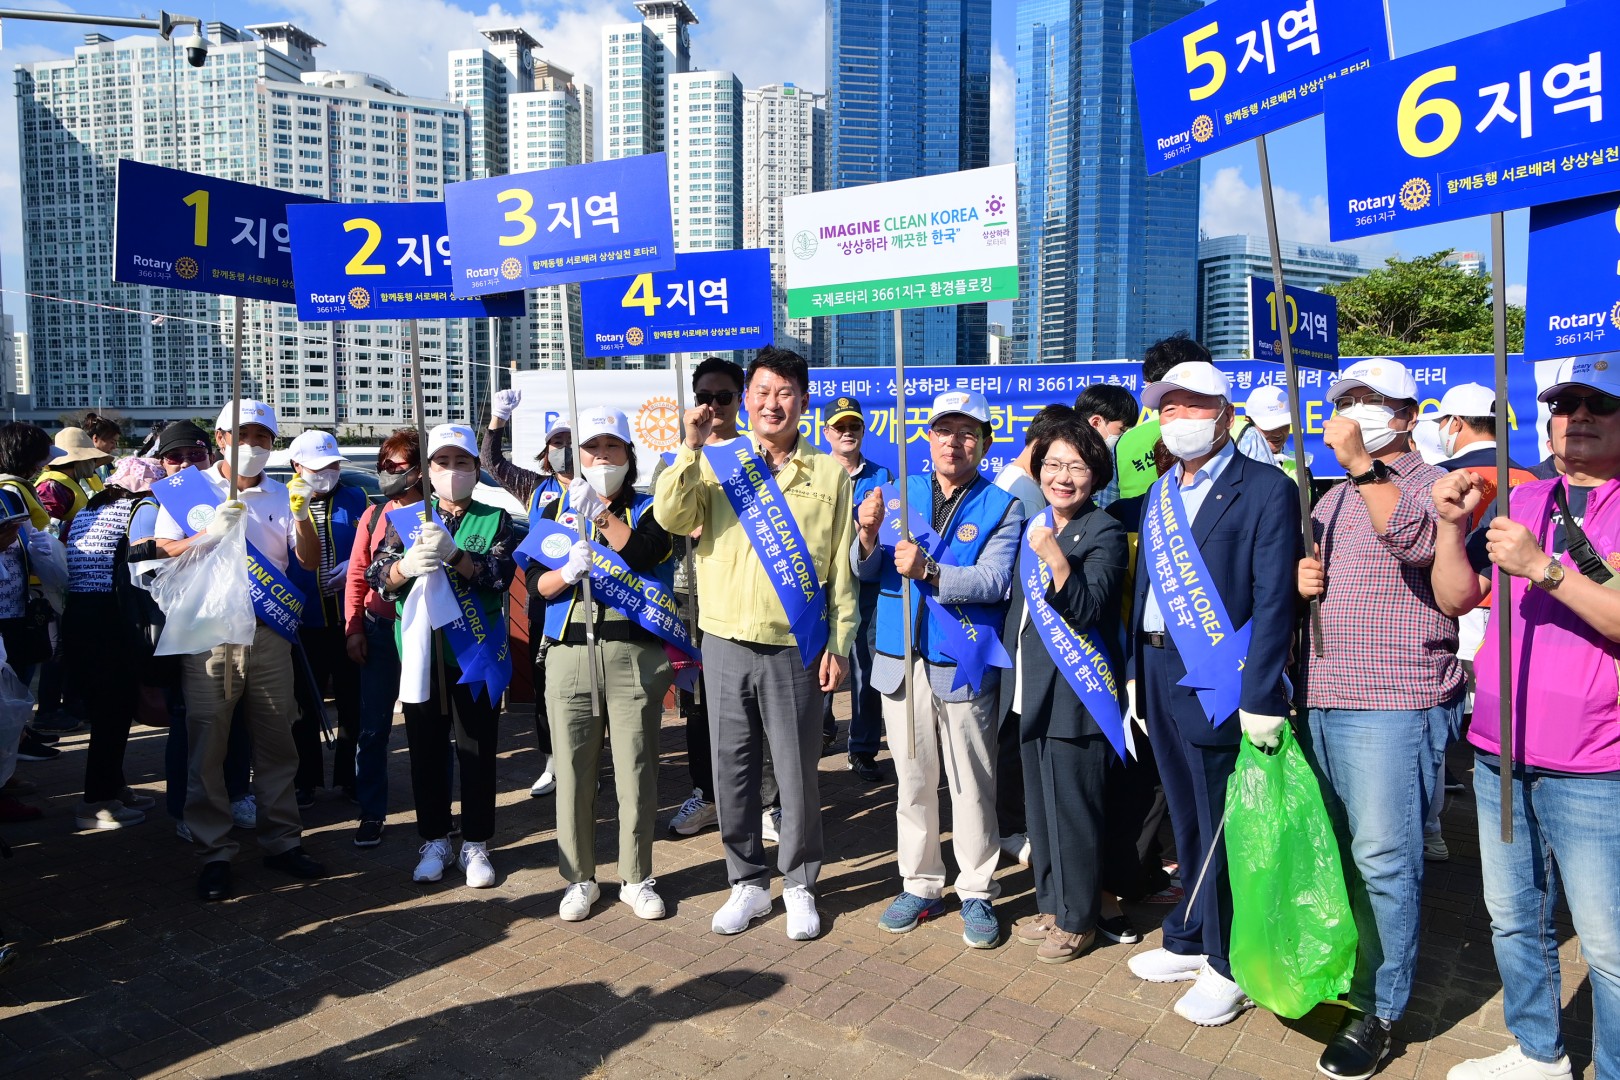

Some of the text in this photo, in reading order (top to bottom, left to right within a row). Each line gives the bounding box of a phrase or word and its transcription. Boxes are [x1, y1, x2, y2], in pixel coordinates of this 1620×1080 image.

[1182, 0, 1320, 101] 5 지역
[1224, 103, 1259, 125] 함께동행
[1261, 87, 1297, 111] 서로배려
[1397, 51, 1602, 158] 6 지역
[1157, 128, 1190, 150] Rotary
[1163, 143, 1192, 161] 3661지구
[1447, 146, 1620, 194] 함께동행 서로배려 상상실천
[1348, 193, 1396, 214] Rotary
[182, 189, 209, 247] 1
[496, 188, 620, 247] 3 지역
[819, 207, 979, 240] IMAGINE CLEAN KOREA
[1355, 210, 1397, 227] 3661지구
[891, 231, 928, 249] 깨끗한
[982, 228, 1010, 240] 상상하라
[986, 237, 1007, 247] 로타리
[342, 218, 386, 275] 2
[532, 245, 657, 270] 함께동행 서로배려 상상실천 로타리
[133, 255, 173, 271] Rotary
[138, 269, 172, 280] 3661지구
[466, 265, 499, 279] Rotary
[212, 268, 245, 282] 함께동행
[247, 274, 279, 286] 서로배려
[471, 278, 500, 288] 3661지구
[310, 291, 346, 306] Rotary
[380, 292, 413, 302] 함께동행
[415, 291, 447, 301] 서로배려
[621, 272, 729, 317] 4 지역
[811, 276, 993, 309] 국제로타리 3661지구 환경플로킹
[316, 305, 347, 314] 3661지구
[1549, 311, 1606, 331] Rotary
[595, 333, 624, 344] Rotary
[653, 326, 760, 340] 함께동행 서로배려 상상실천 로타리
[1300, 311, 1328, 343] 지역
[1555, 330, 1605, 346] 3661지구
[600, 343, 625, 351] 3661지구
[841, 379, 872, 396] 테마
[1018, 377, 1032, 392] RI
[981, 457, 1003, 472] 9월
[734, 448, 774, 506] IMAGINE
[767, 505, 798, 552] CLEAN
[789, 544, 815, 603] KOREA
[755, 519, 782, 559] 깨끗한
[1156, 550, 1180, 594] 깨끗한
[1160, 474, 1225, 647] IMAGINE CLEAN KOREA
[591, 551, 677, 615] MAGINE CLEAN
[263, 599, 291, 625] 깨끗한
[461, 599, 487, 645] KOREA
[641, 605, 673, 632] 깨끗한
[1050, 625, 1082, 667] 깨끗한
[1090, 652, 1119, 702] KOREA
